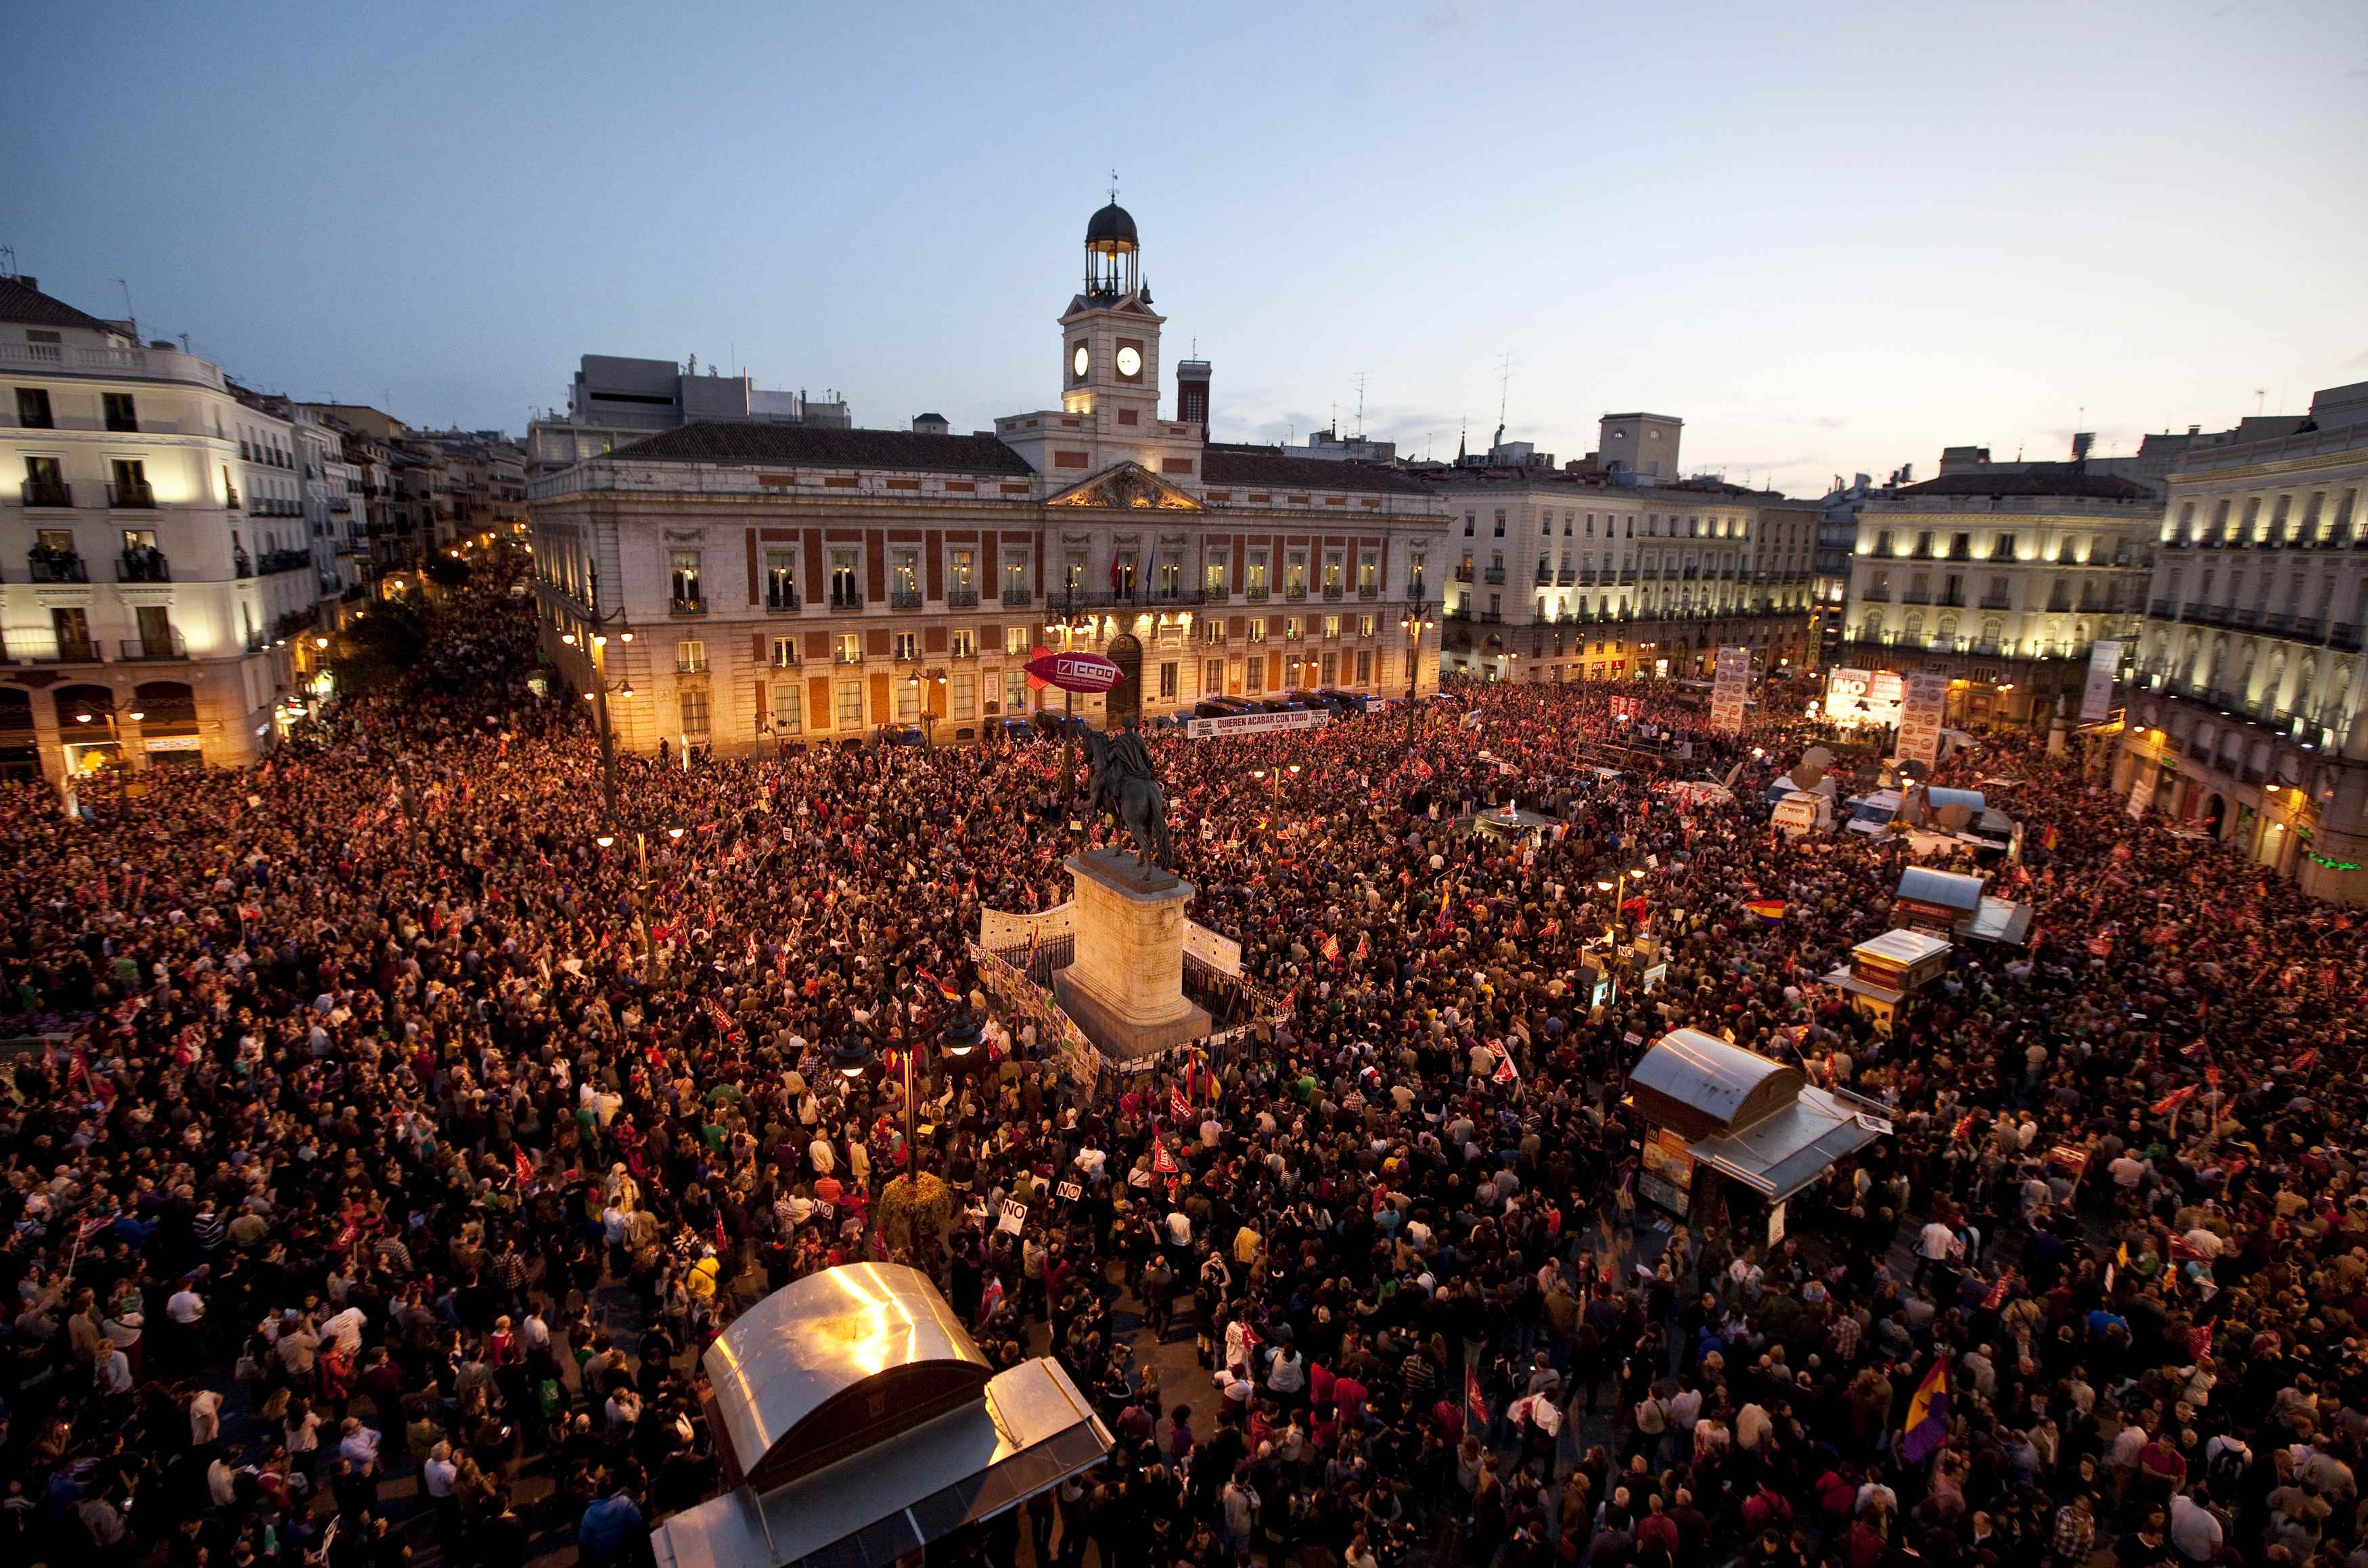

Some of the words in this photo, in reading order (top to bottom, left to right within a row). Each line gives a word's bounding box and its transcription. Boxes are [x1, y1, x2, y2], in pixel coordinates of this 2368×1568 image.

[1076, 664, 1113, 678] CCOO
[1830, 677, 1867, 695] NO
[1197, 720, 1212, 729] HUELGA
[1218, 718, 1246, 729] QUIEREN
[1248, 716, 1274, 726] ACABAR
[1276, 714, 1290, 722] CON
[1292, 713, 1308, 722] TODO
[1311, 716, 1326, 725] NO
[1197, 728, 1213, 737] GENERAL
[976, 948, 986, 958] NO
[1620, 947, 1633, 956] NO
[1057, 1184, 1079, 1199] NO
[813, 1200, 832, 1217] NO
[1003, 1202, 1026, 1219] NO
